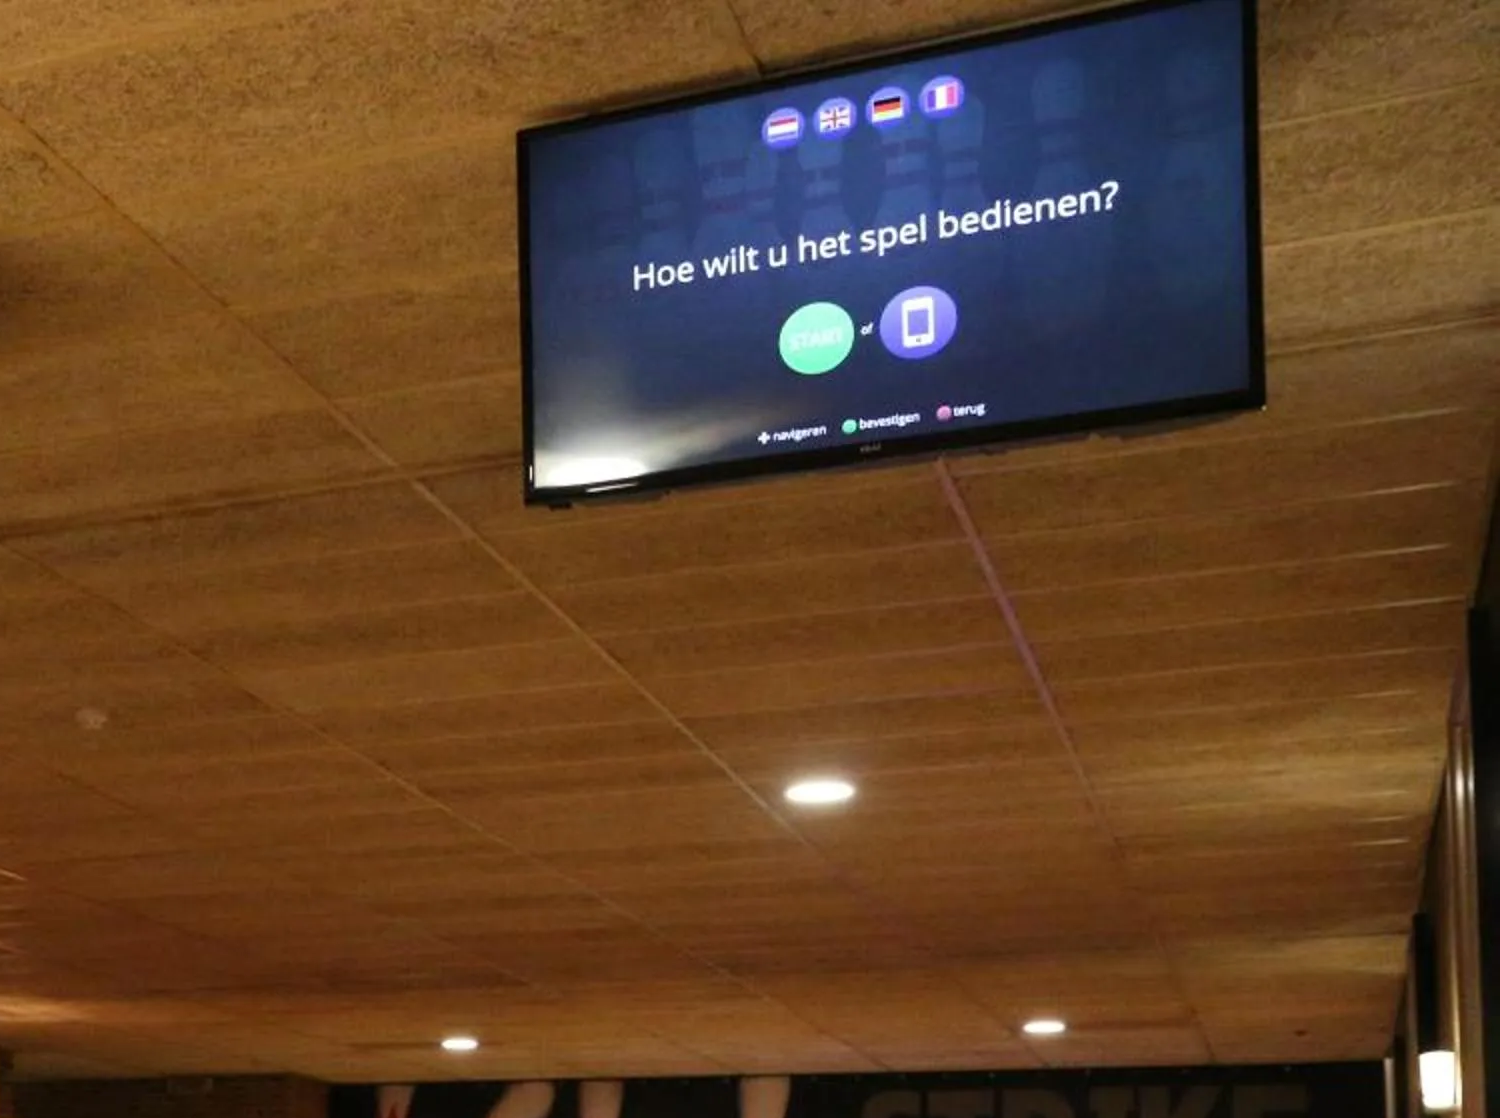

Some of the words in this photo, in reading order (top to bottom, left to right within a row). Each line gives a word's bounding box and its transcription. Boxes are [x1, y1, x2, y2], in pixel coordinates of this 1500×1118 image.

[632, 261, 694, 291] Hoe
[703, 246, 758, 278] wilt
[768, 244, 787, 268] u
[798, 231, 850, 263] het
[859, 214, 927, 257] spel
[938, 181, 1119, 239] bedienen?
[773, 426, 827, 442] navigeren
[859, 412, 921, 431] bevestigen
[953, 403, 986, 417] terug
